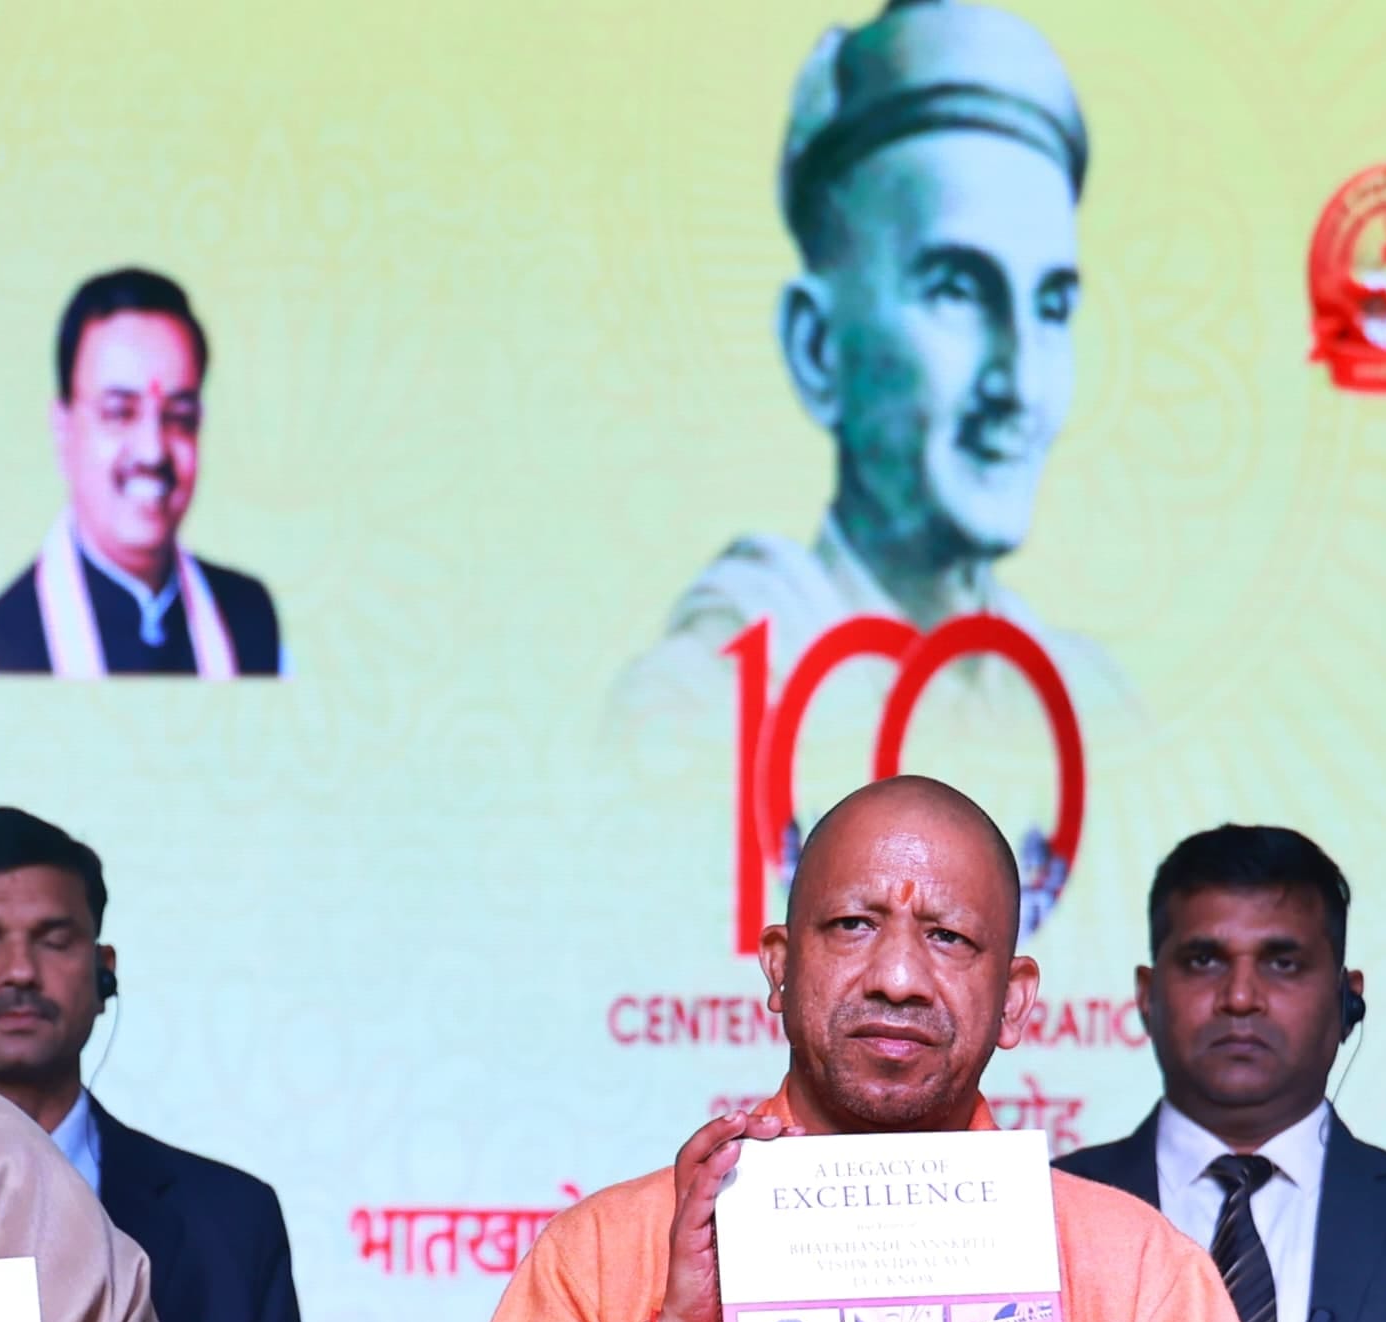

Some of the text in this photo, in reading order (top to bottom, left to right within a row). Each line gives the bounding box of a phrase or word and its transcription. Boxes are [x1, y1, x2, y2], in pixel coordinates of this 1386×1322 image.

[607, 994, 786, 1046] CENTEN
[834, 1159, 916, 1179] LEGACY
[922, 1158, 950, 1176] OF
[772, 1180, 999, 1211] EXCELLENCE
